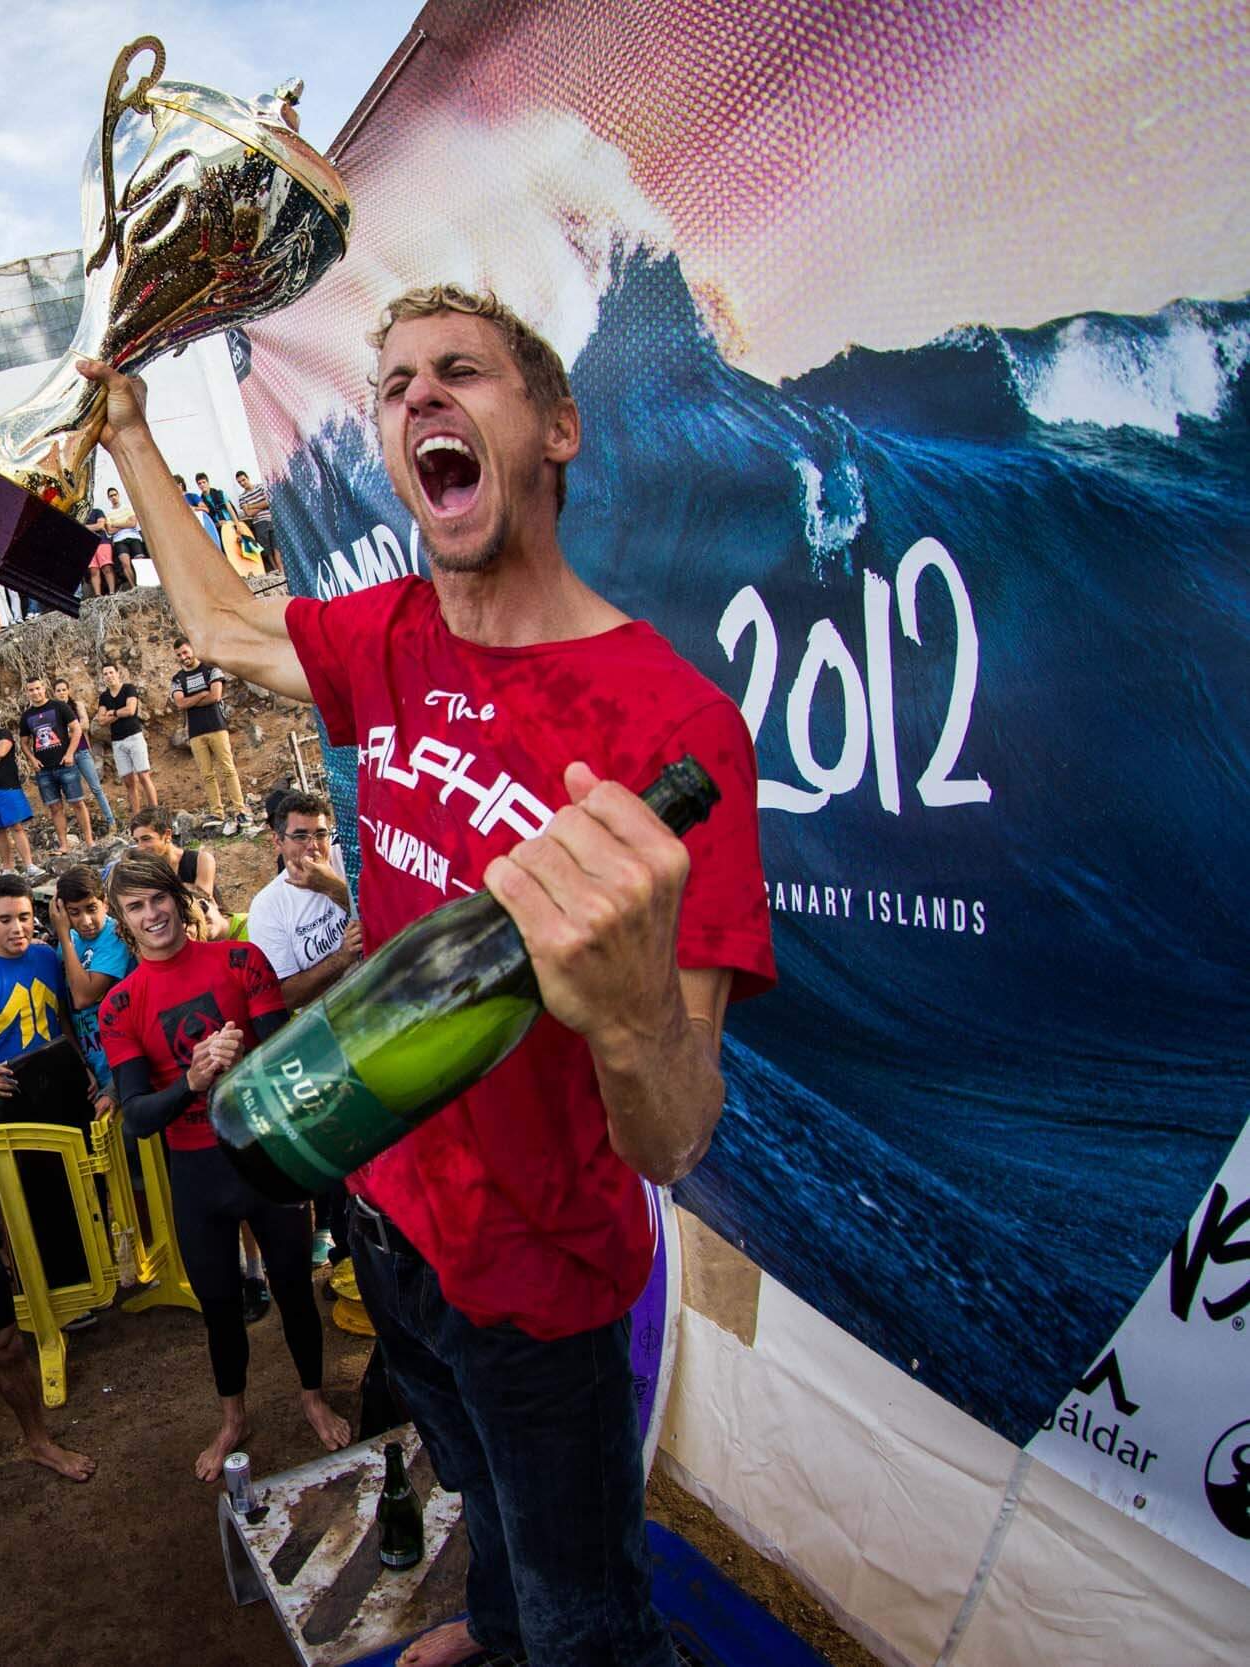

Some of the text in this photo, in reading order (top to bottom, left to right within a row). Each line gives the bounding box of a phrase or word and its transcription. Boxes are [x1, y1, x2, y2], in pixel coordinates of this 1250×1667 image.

[716, 536, 992, 816] 2012
[424, 689, 496, 723] The
[868, 890, 986, 935] ISLANDS
